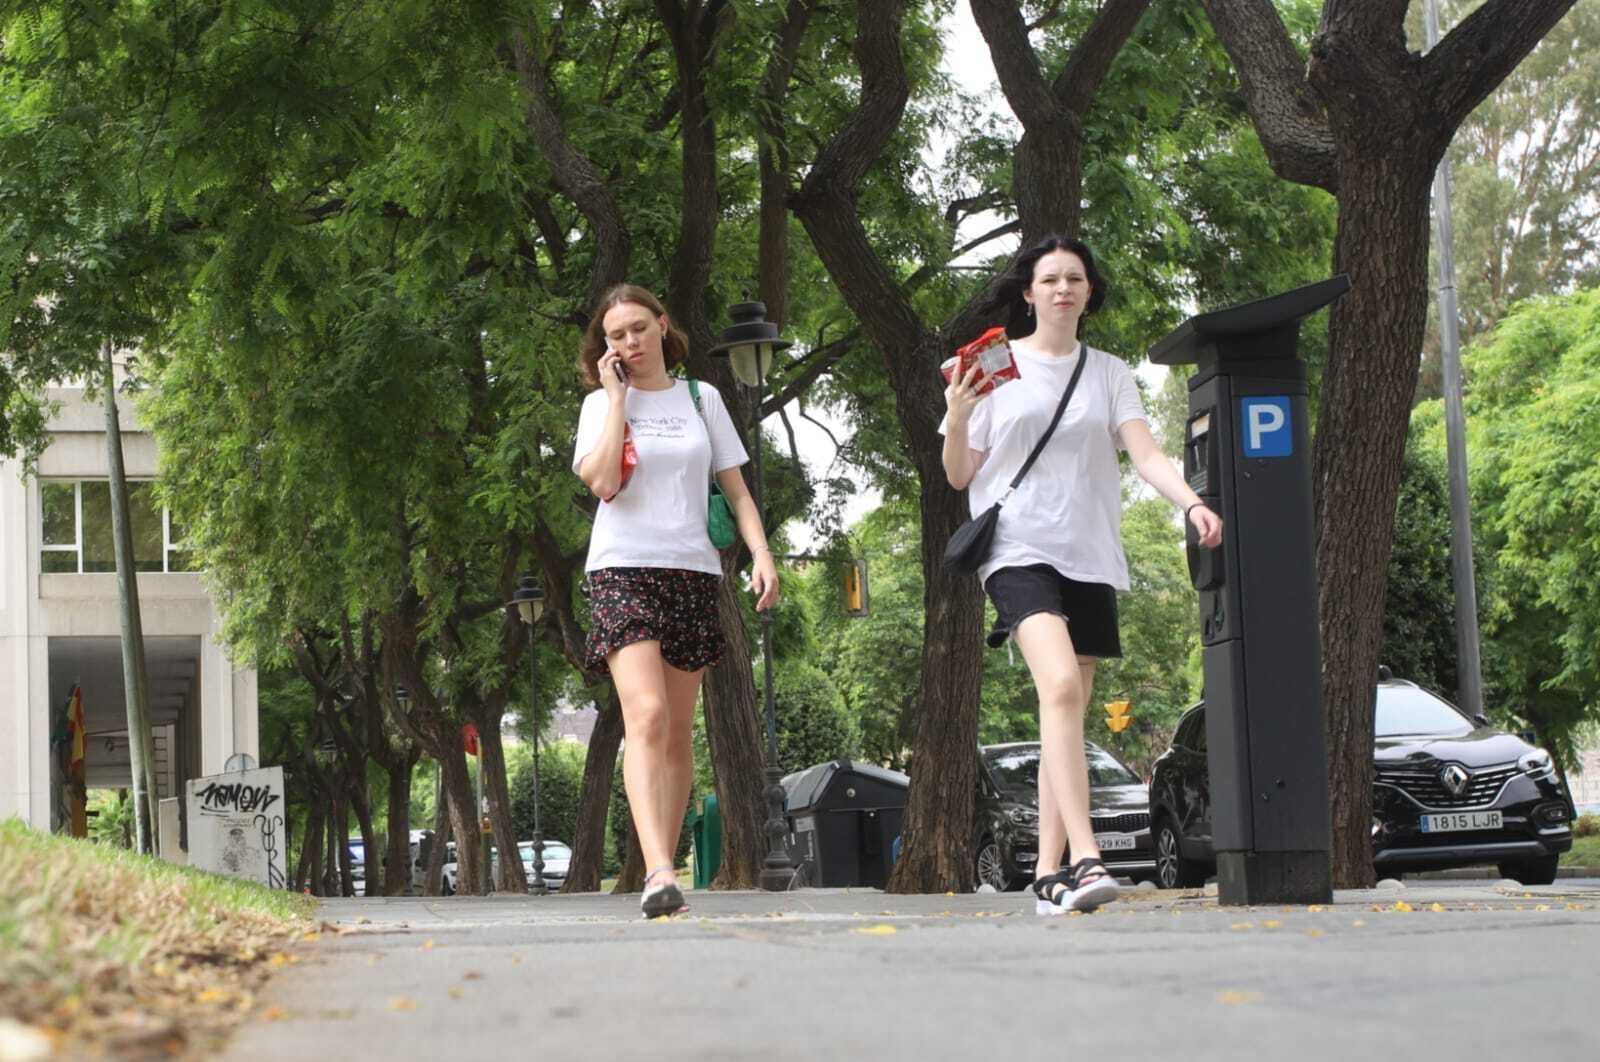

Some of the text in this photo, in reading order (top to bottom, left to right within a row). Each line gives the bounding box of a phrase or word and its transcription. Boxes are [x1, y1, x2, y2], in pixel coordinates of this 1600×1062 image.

[1248, 404, 1285, 450] P
[1432, 812, 1500, 830] 1815 LJR
